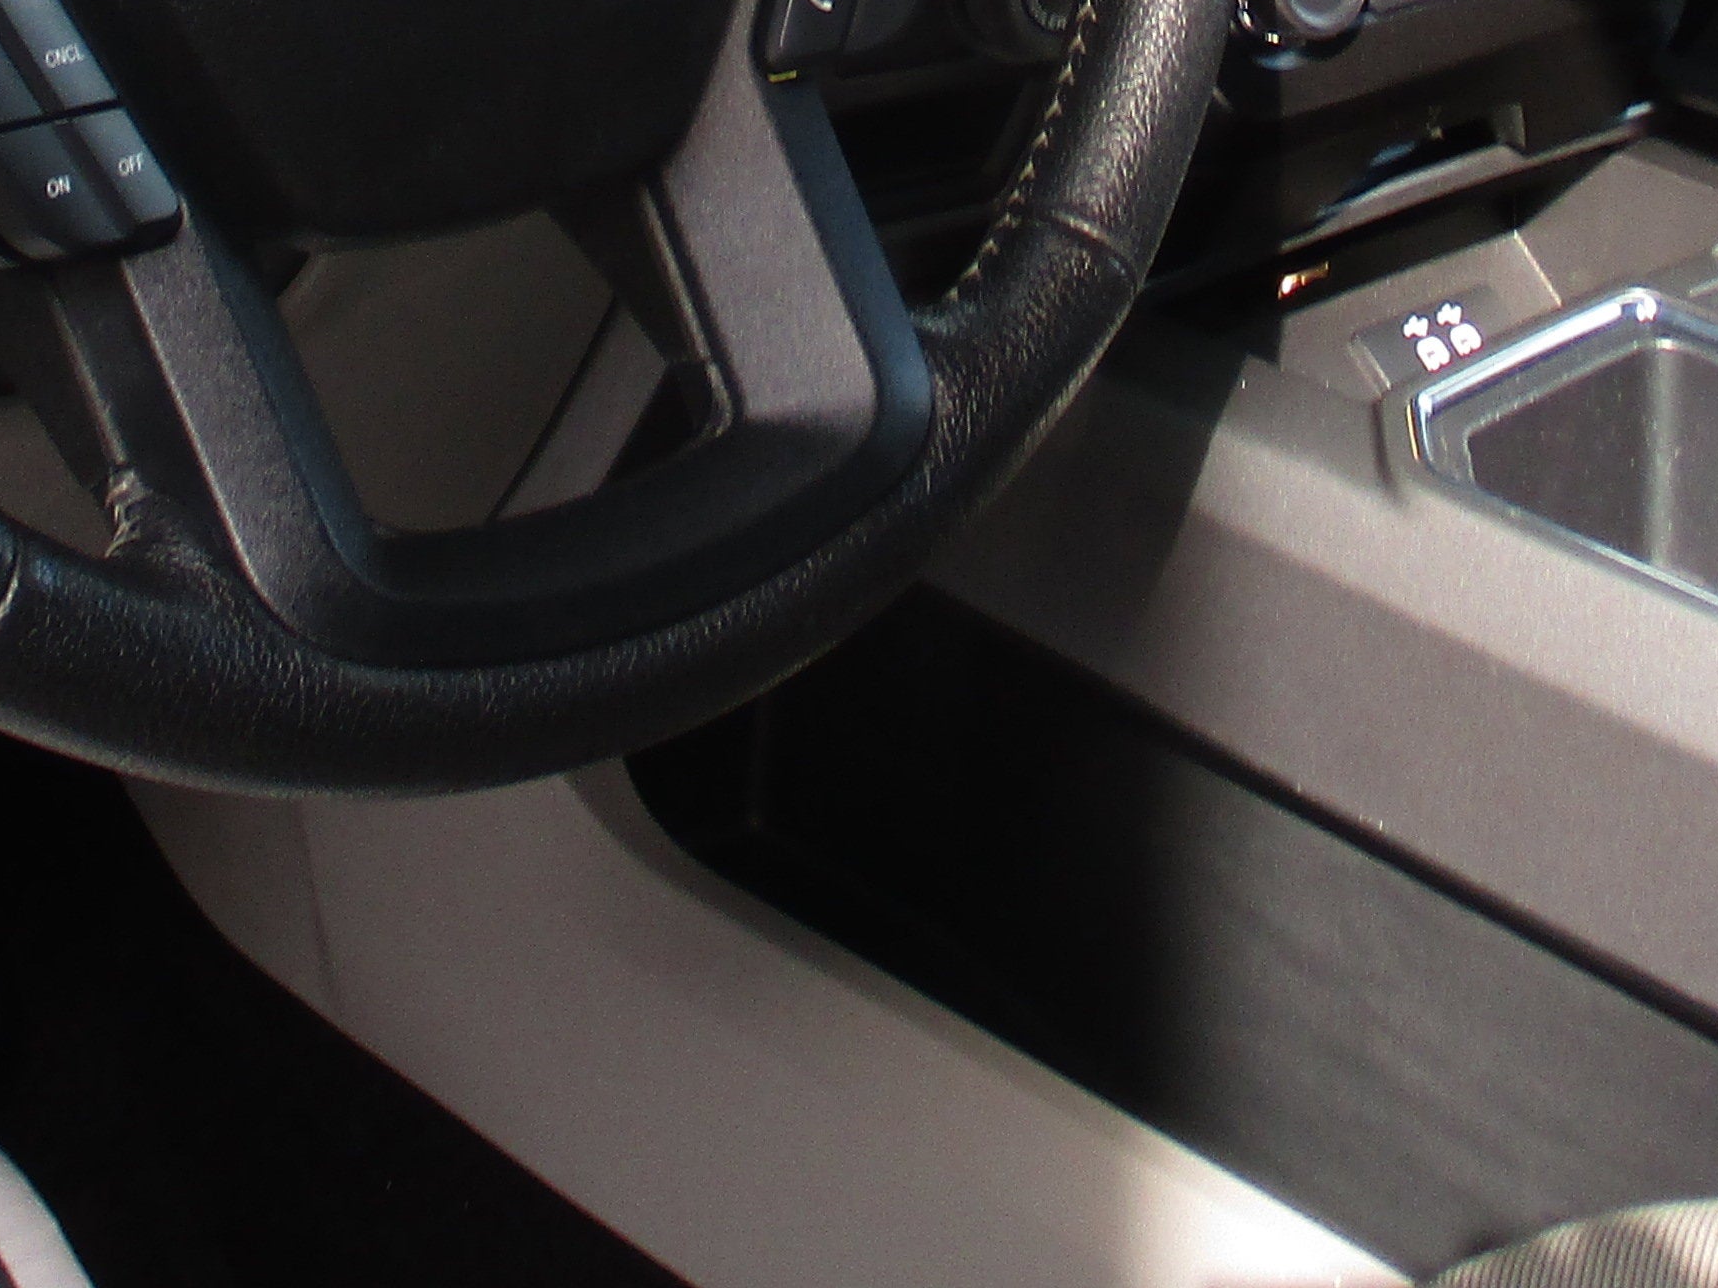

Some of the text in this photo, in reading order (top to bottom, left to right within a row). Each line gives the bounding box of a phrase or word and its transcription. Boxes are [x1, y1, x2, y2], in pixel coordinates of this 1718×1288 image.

[45, 42, 84, 69] CNCL
[118, 152, 144, 176] OFF
[46, 174, 71, 200] ON
